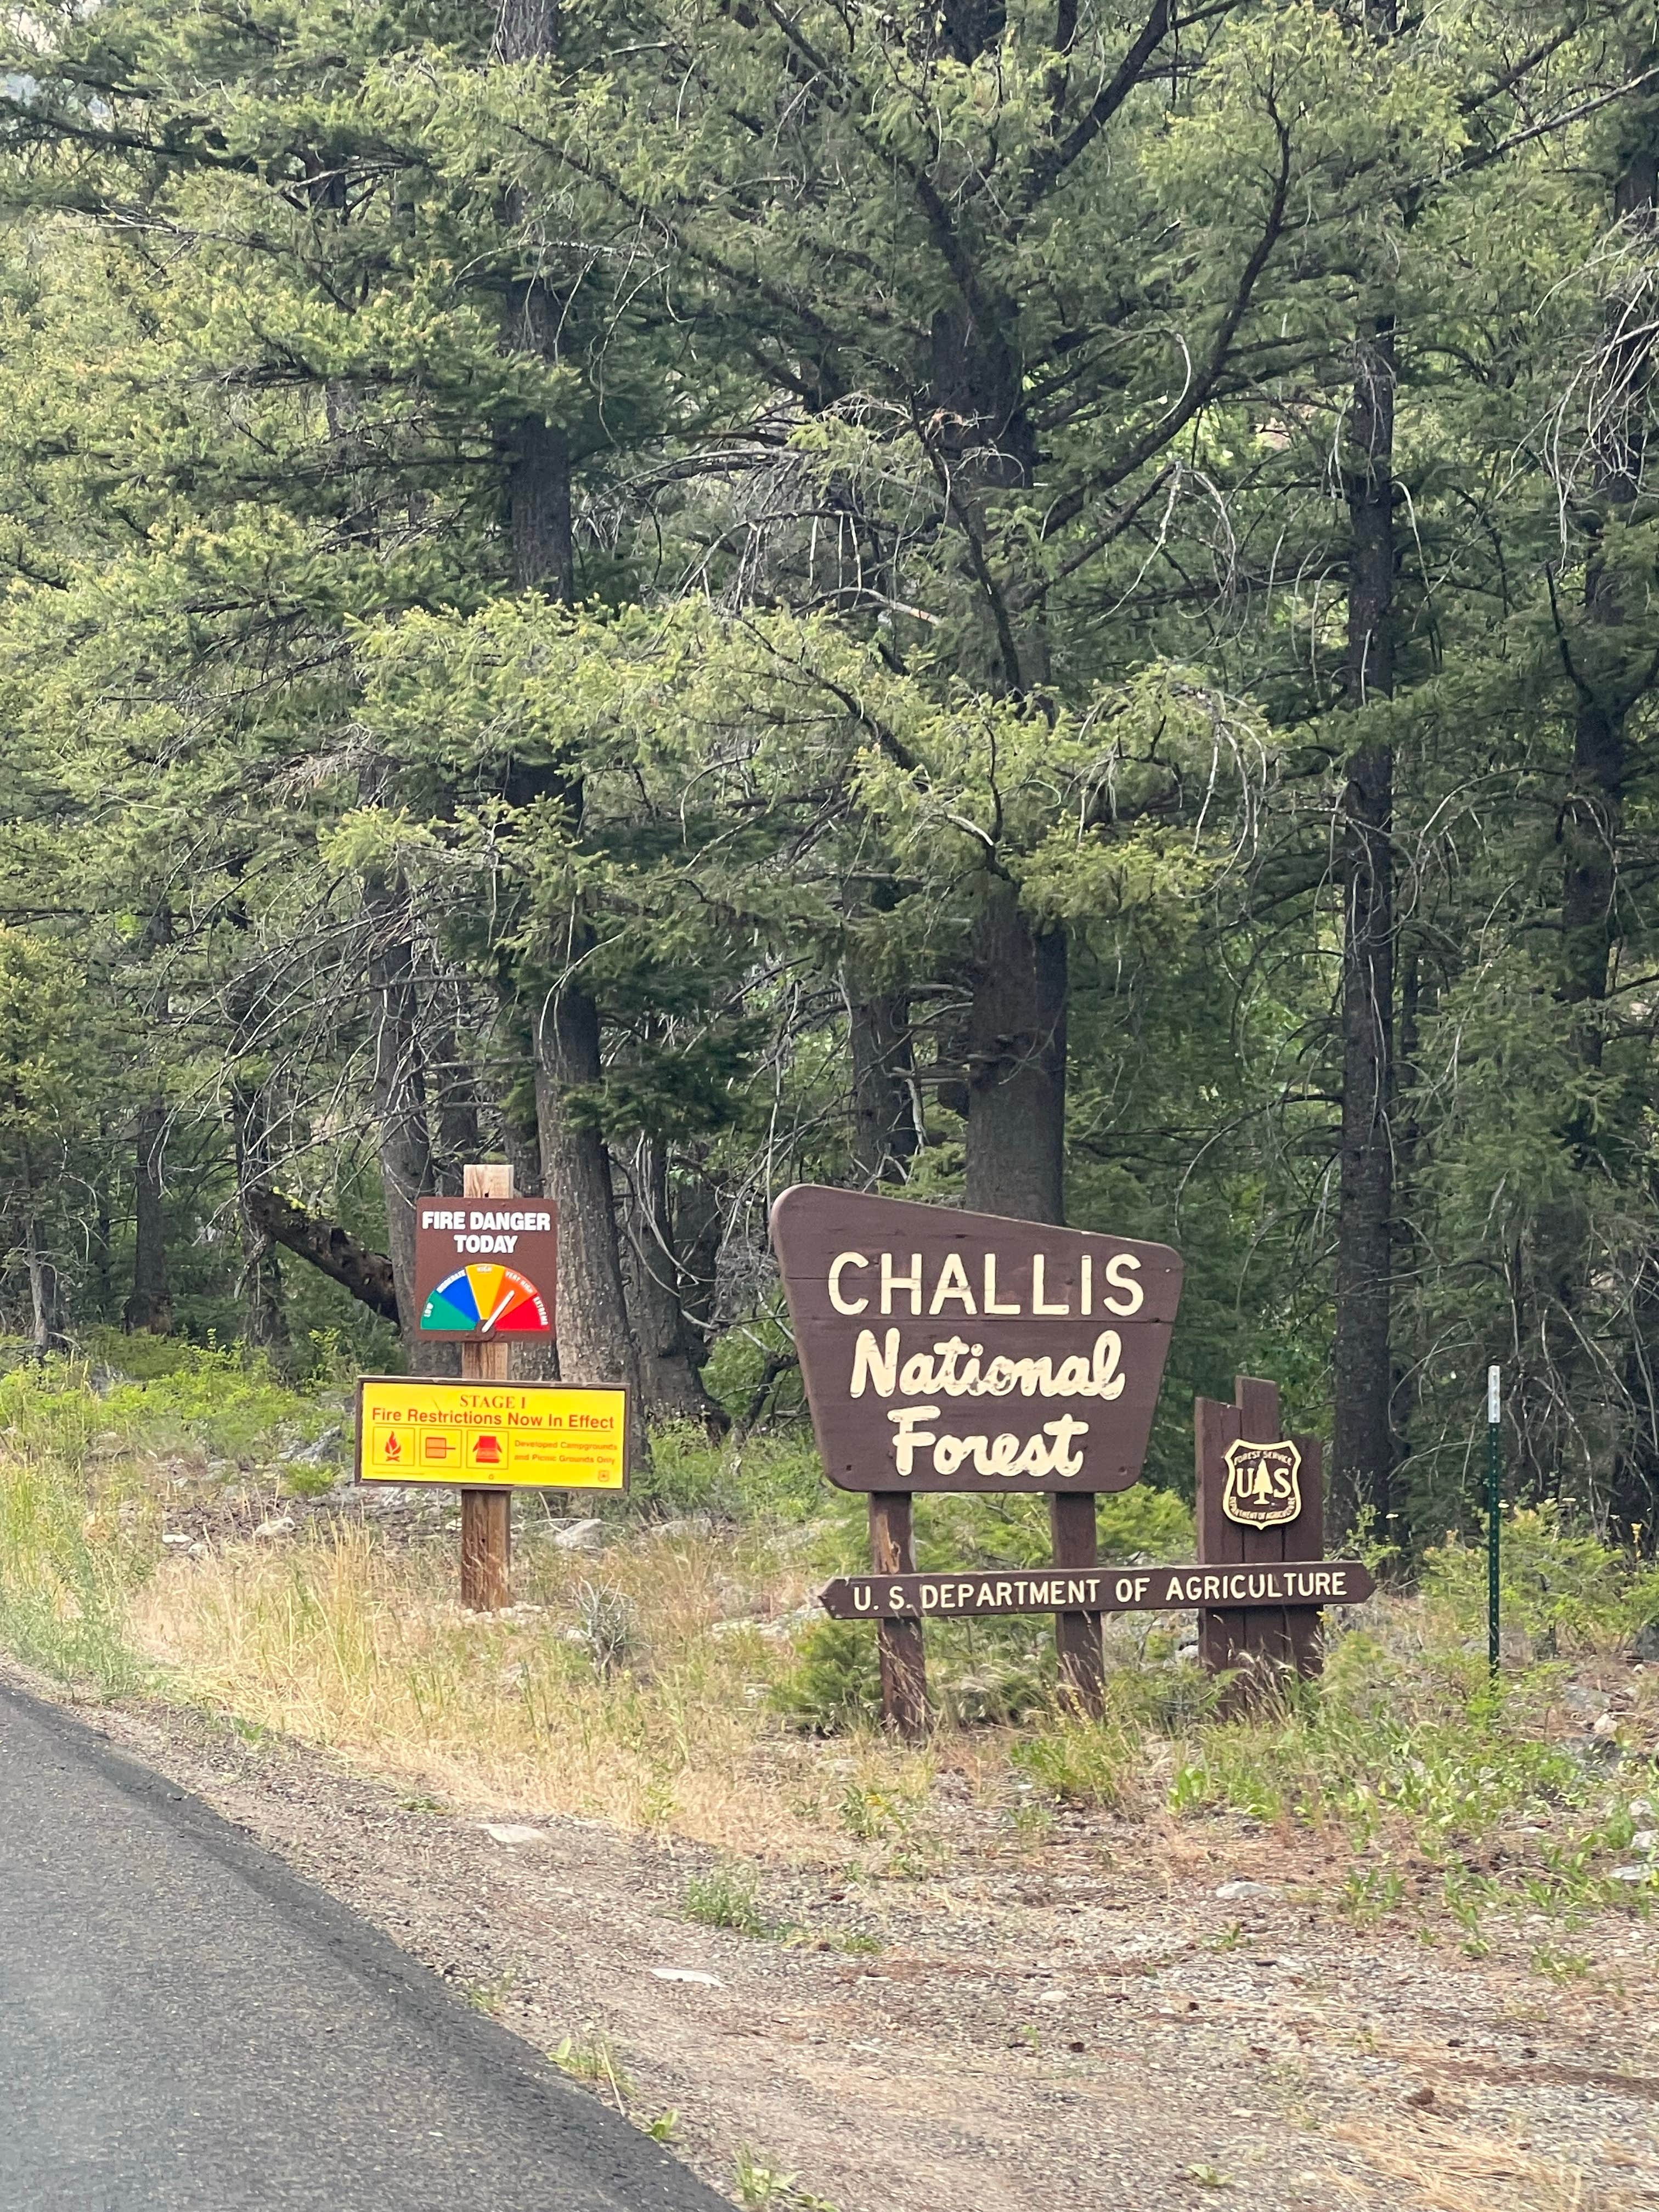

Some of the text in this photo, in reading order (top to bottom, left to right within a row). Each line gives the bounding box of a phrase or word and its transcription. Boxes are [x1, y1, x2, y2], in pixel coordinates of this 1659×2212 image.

[422, 1211, 551, 1231] FIRE DANGER
[454, 1234, 518, 1254] TODAY
[827, 1251, 1144, 1316] CHALLIS
[850, 1328, 1126, 1401] National
[460, 1395, 515, 1409] STAGE
[373, 1408, 614, 1429] Fire Restrictions Now In Effect
[515, 1440, 618, 1451] Developed Campgrounds
[887, 1406, 1090, 1477] Forest
[597, 1456, 615, 1465] Only
[1234, 1451, 1293, 1466] FOREST SERVICE
[854, 1572, 1347, 1611] U. S. DEPARTMENT OF AGRICULTURE
